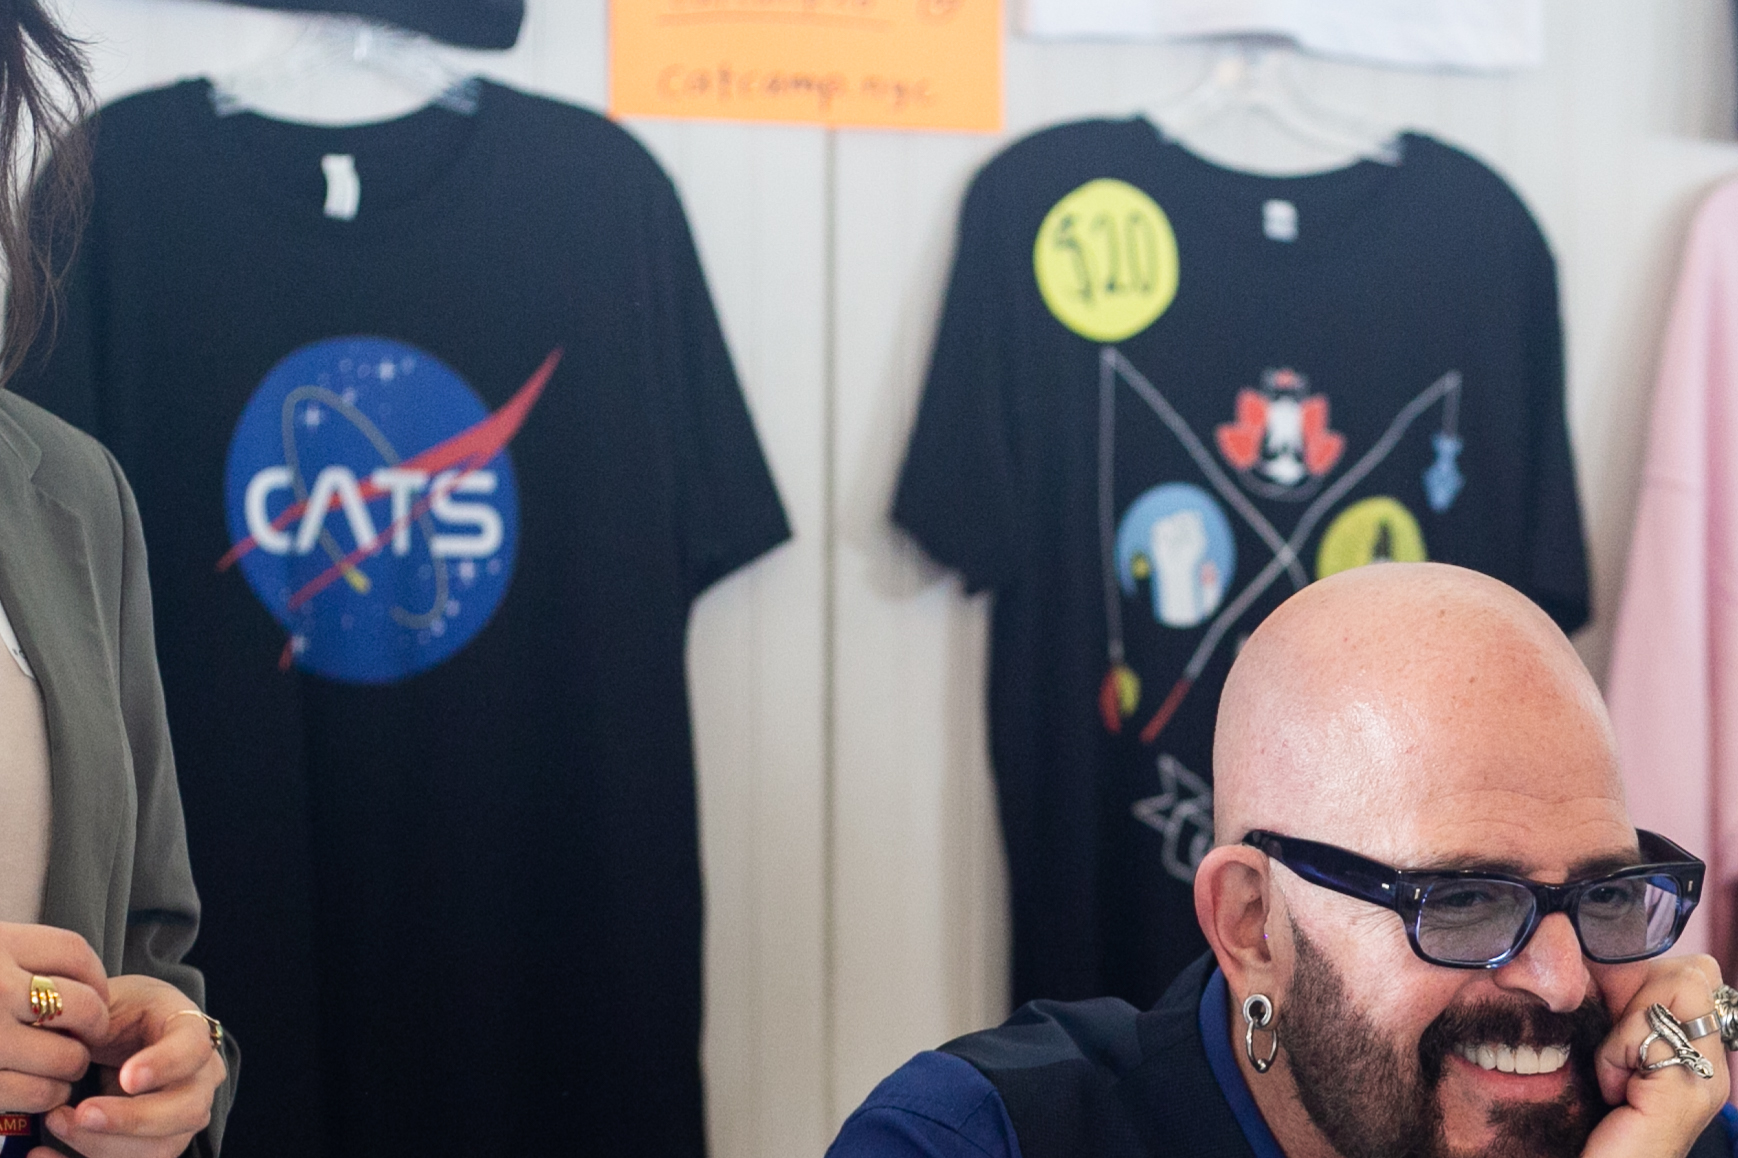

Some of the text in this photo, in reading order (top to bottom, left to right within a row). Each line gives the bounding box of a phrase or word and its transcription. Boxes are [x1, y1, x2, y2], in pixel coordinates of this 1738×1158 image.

[1051, 212, 1158, 308] $20
[244, 464, 504, 556] CATS
[0, 1118, 27, 1132] MP
